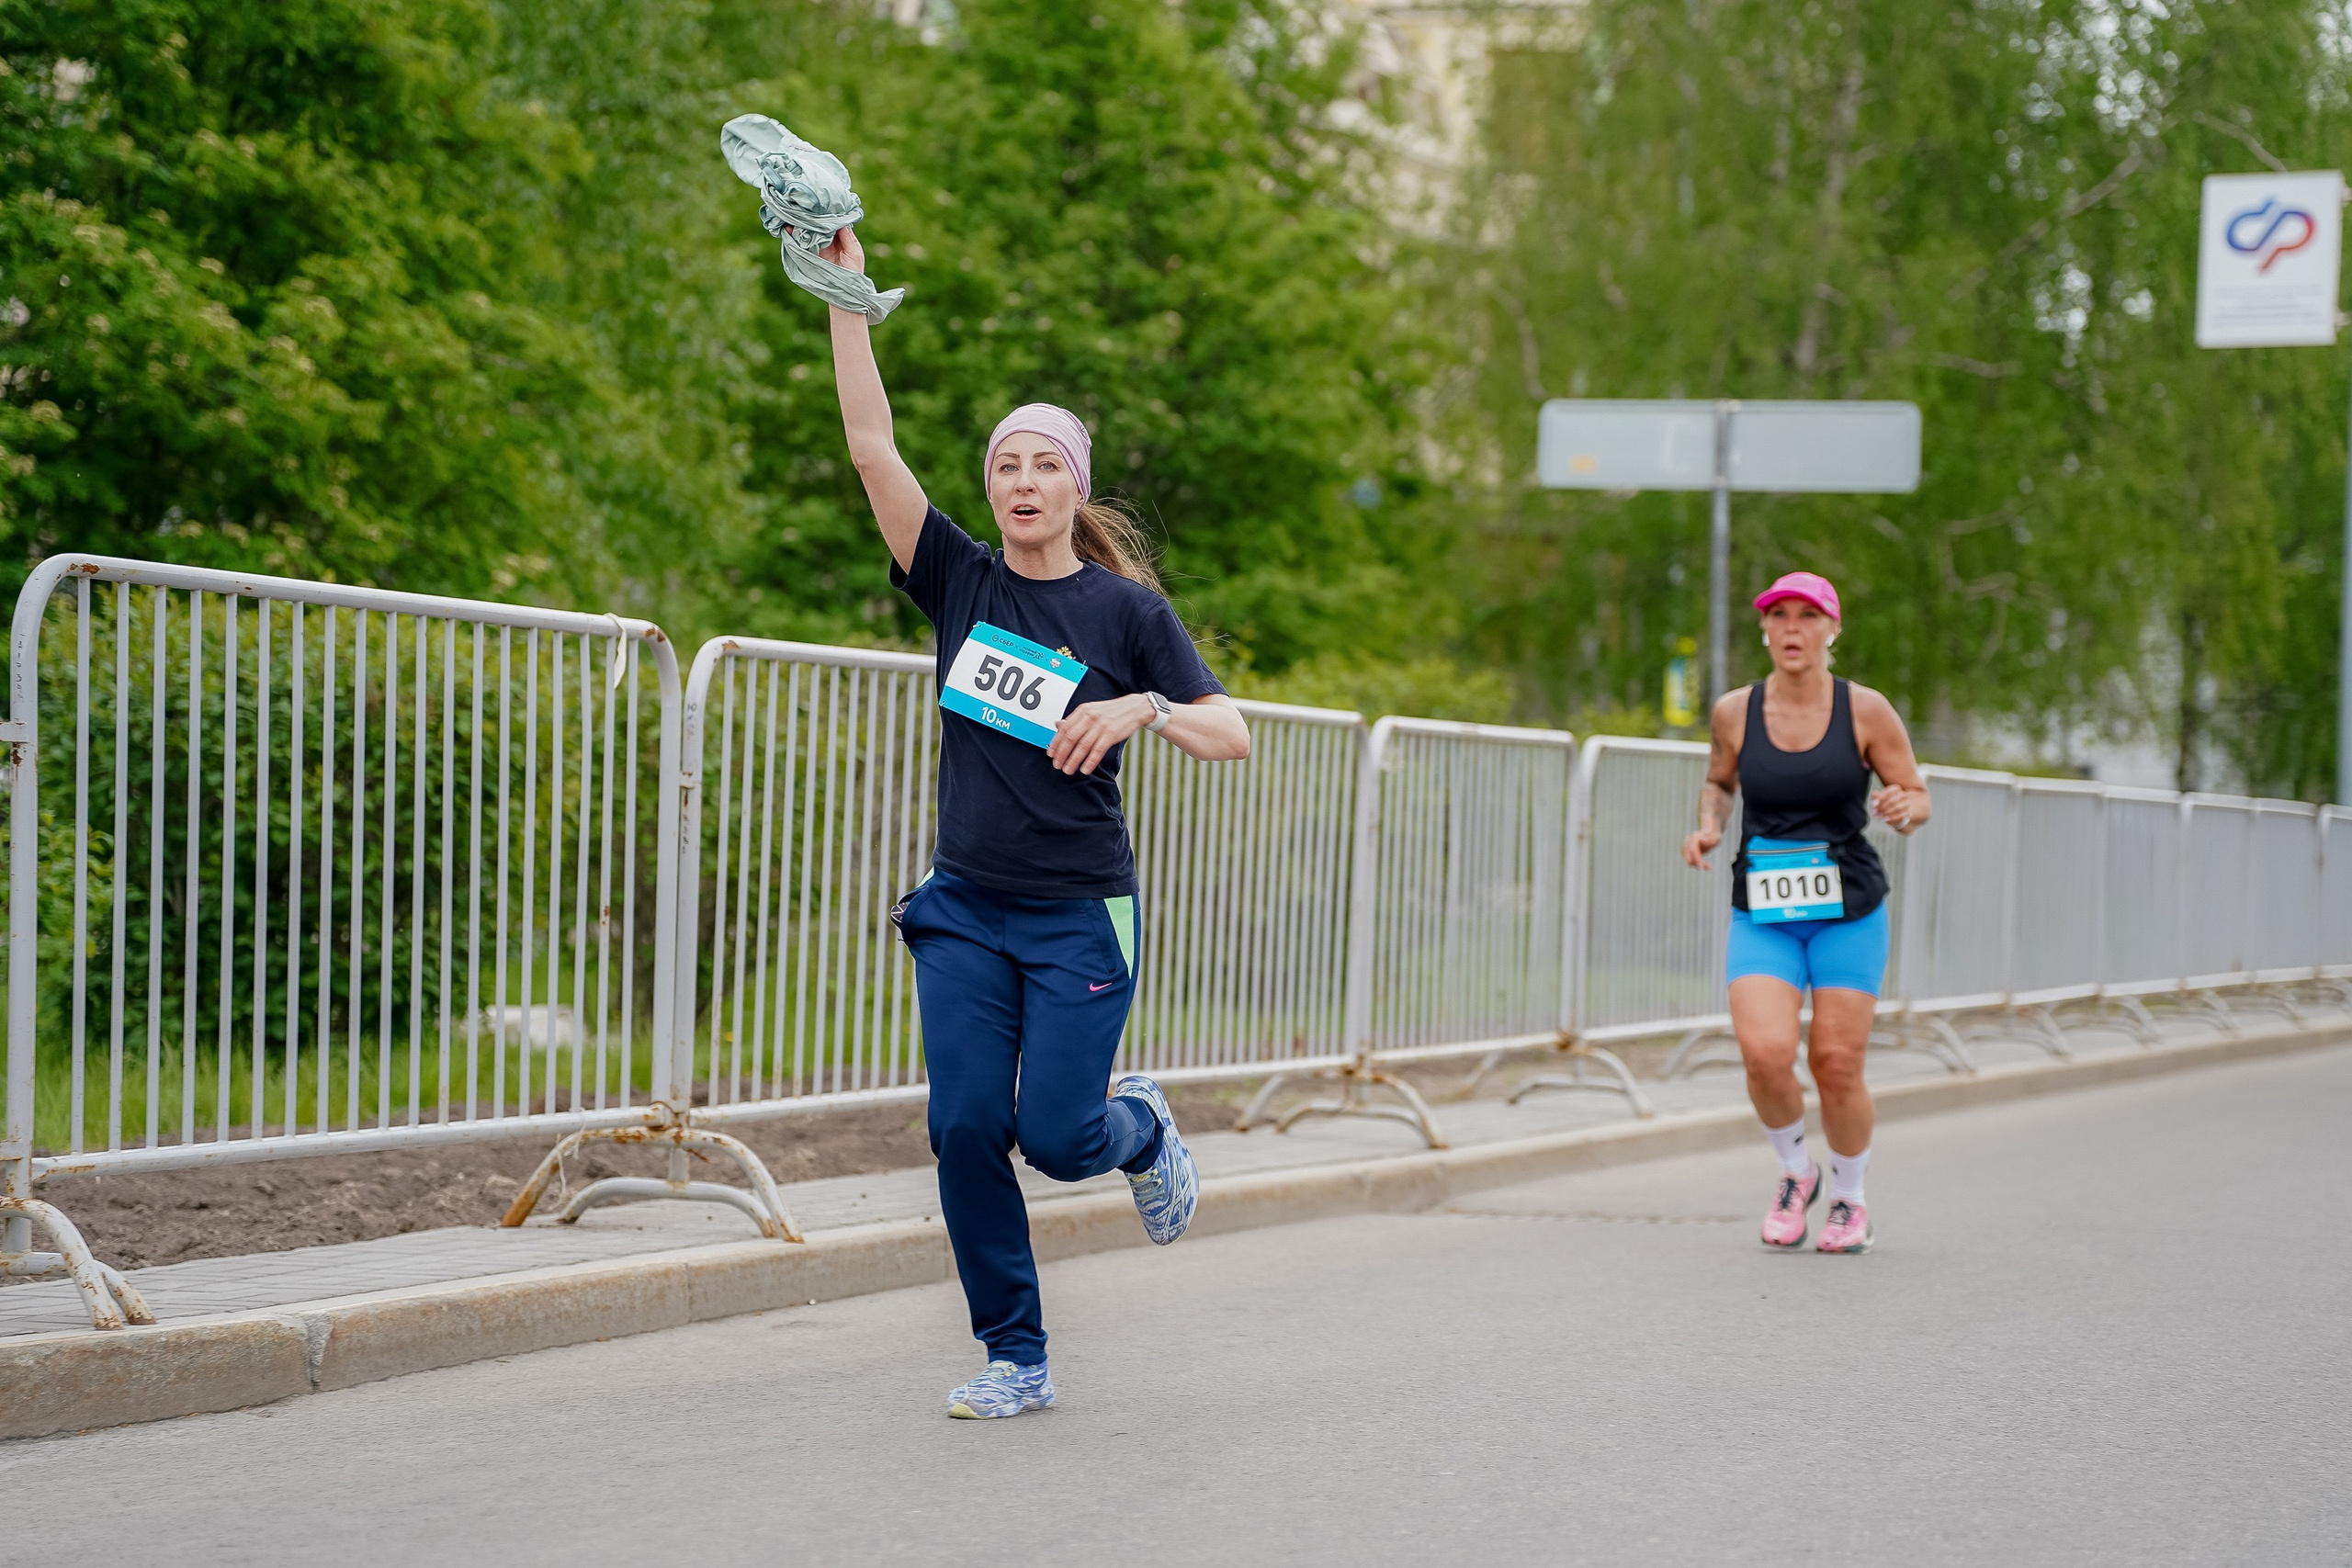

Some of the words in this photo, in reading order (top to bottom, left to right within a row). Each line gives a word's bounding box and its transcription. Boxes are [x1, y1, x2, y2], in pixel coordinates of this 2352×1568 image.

[999, 637, 1014, 647] СБЕР
[974, 654, 1046, 711] 506
[1760, 874, 1829, 900] 1010
